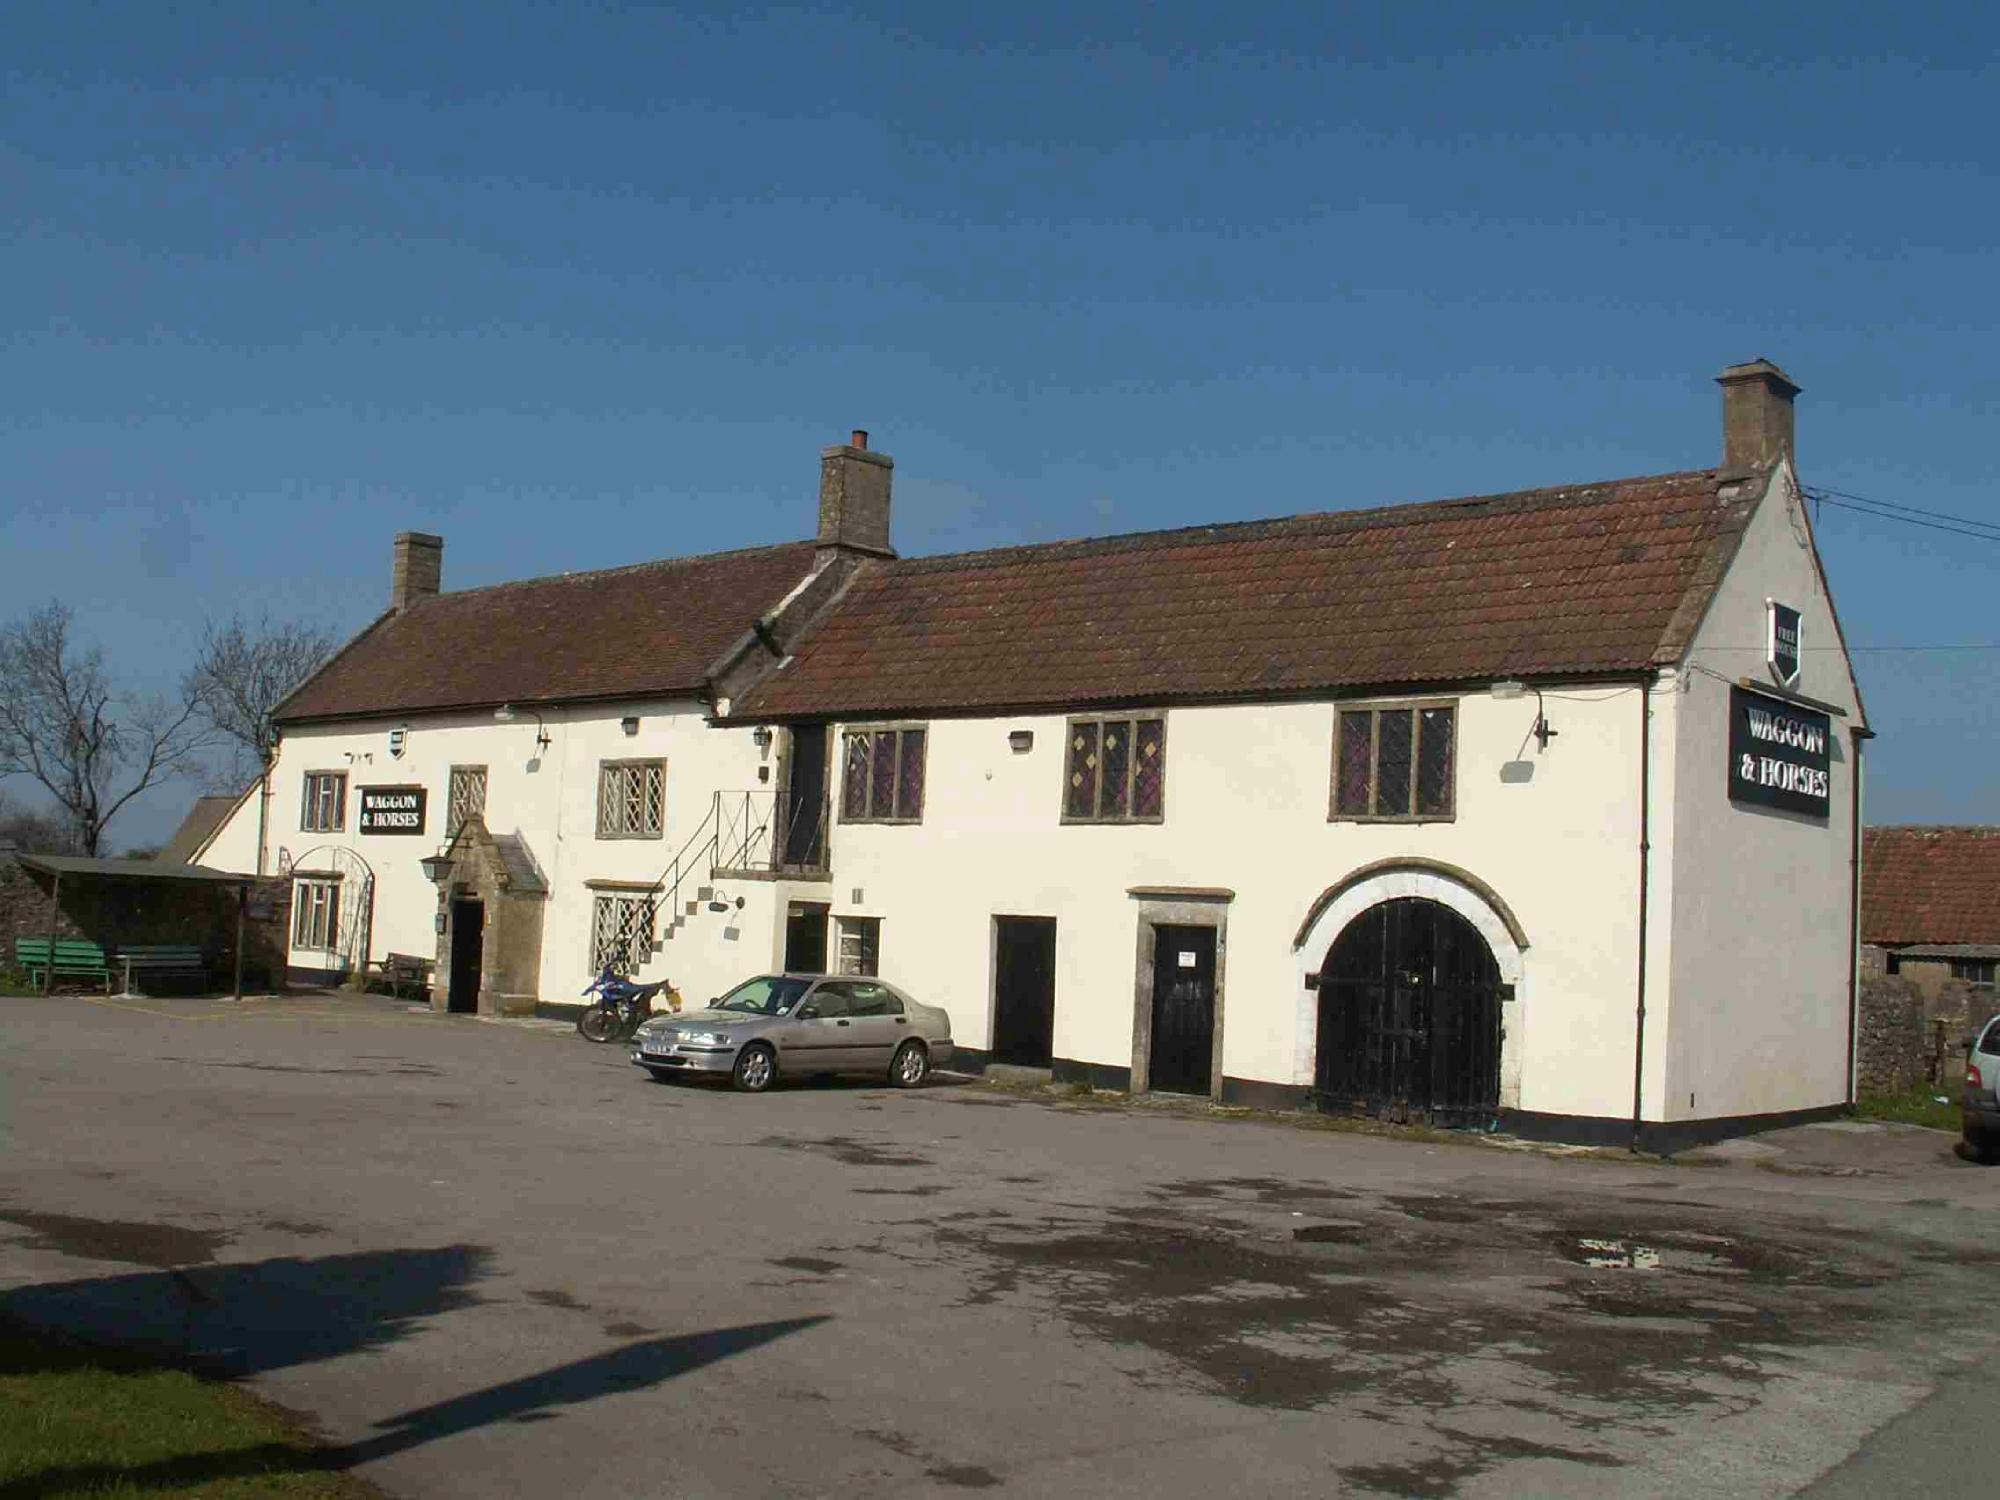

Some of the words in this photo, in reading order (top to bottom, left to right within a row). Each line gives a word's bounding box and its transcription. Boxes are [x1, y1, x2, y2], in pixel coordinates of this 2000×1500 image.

[1747, 707, 1825, 754] WAGGON
[1740, 753, 1756, 782] &
[1760, 756, 1828, 798] HORSES
[366, 795, 417, 808] WAGGON
[362, 813, 371, 826] &
[373, 812, 419, 827] HORSES
